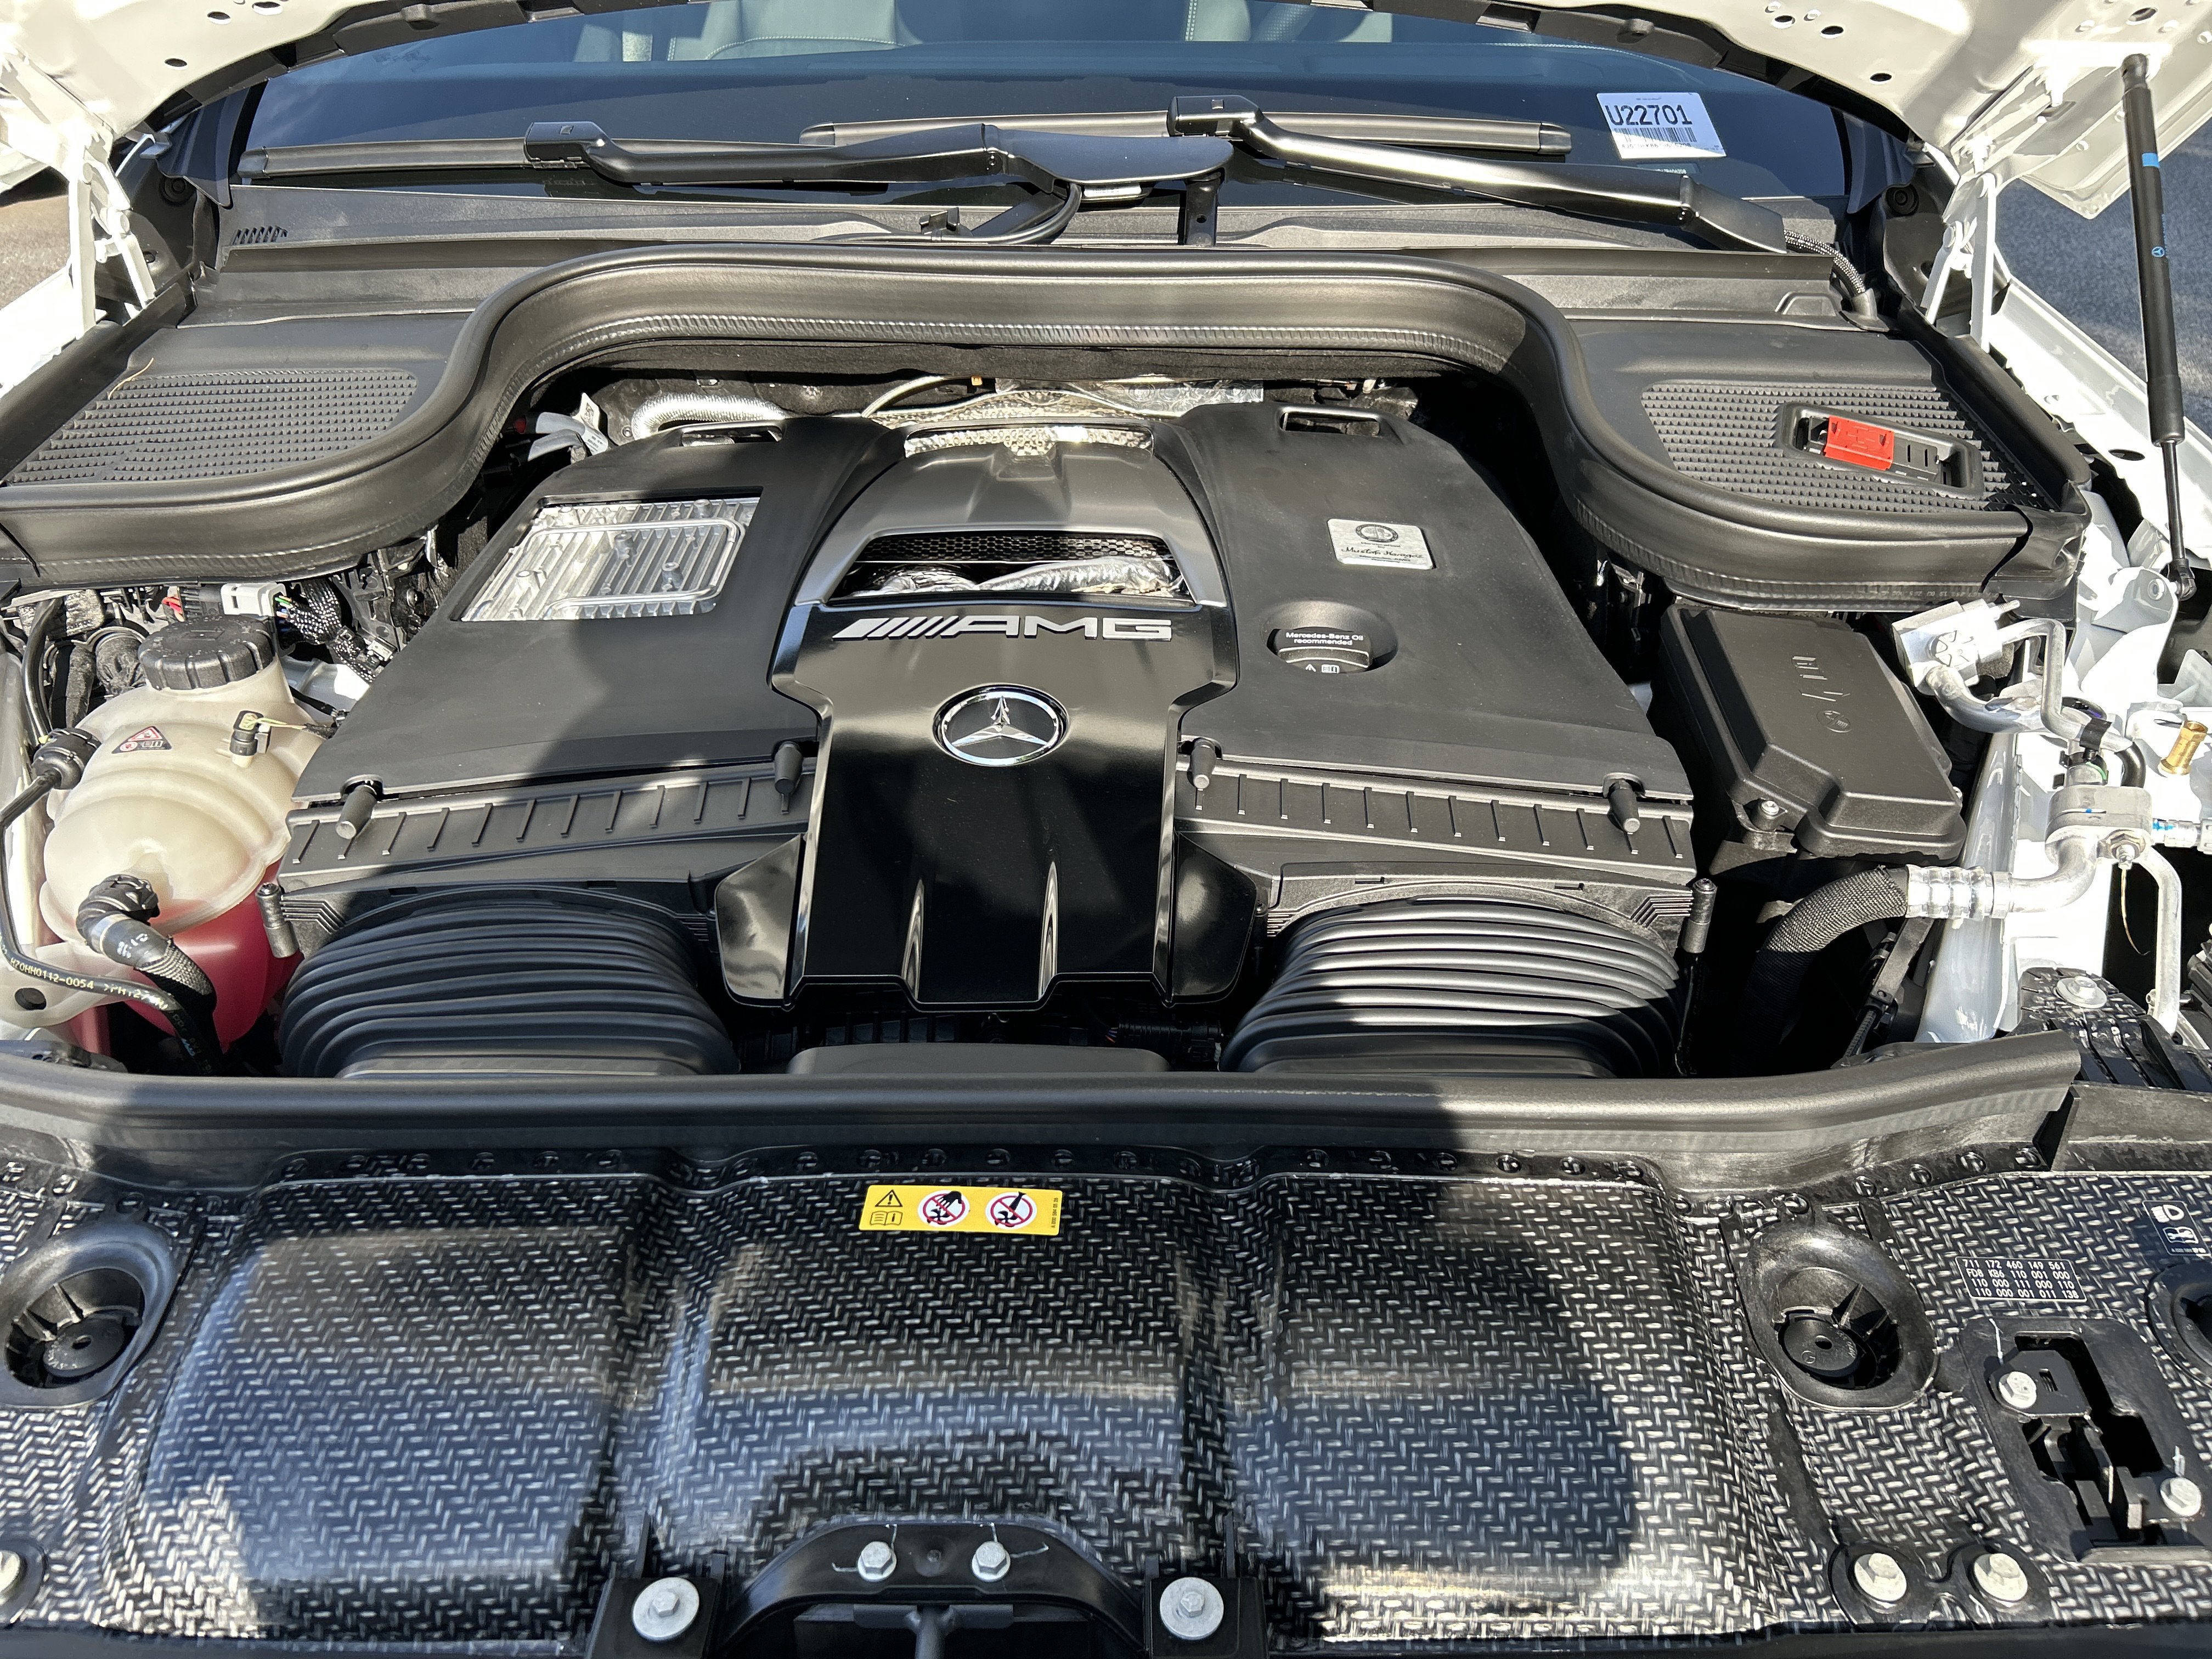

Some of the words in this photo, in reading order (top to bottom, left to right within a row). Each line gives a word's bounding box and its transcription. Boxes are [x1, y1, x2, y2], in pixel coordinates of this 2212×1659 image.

[1605, 105, 1693, 125] U22701
[939, 615, 1172, 641] AMG
[1962, 1259, 1979, 1268] 711
[1985, 1260, 2002, 1268] 172
[2006, 1260, 2023, 1269] 460
[2028, 1261, 2044, 1269] 149
[2048, 1261, 2066, 1270] 561
[1966, 1268, 1984, 1277] FD8
[1988, 1269, 2005, 1278] KB6
[2010, 1270, 2027, 1278] 110
[2031, 1271, 2048, 1279] 001
[2052, 1271, 2070, 1279] 000
[1971, 1278, 1988, 1287] 110
[1992, 1279, 2010, 1288] 000
[2015, 1279, 2030, 1288] 111
[2035, 1280, 2052, 1289] 000
[2057, 1280, 2075, 1289] 110
[1975, 1288, 1992, 1296] 110
[1996, 1289, 2013, 1297] 000
[2018, 1289, 2035, 1298] 001
[2039, 1290, 2056, 1299] 011
[2062, 1290, 2079, 1299] 138
